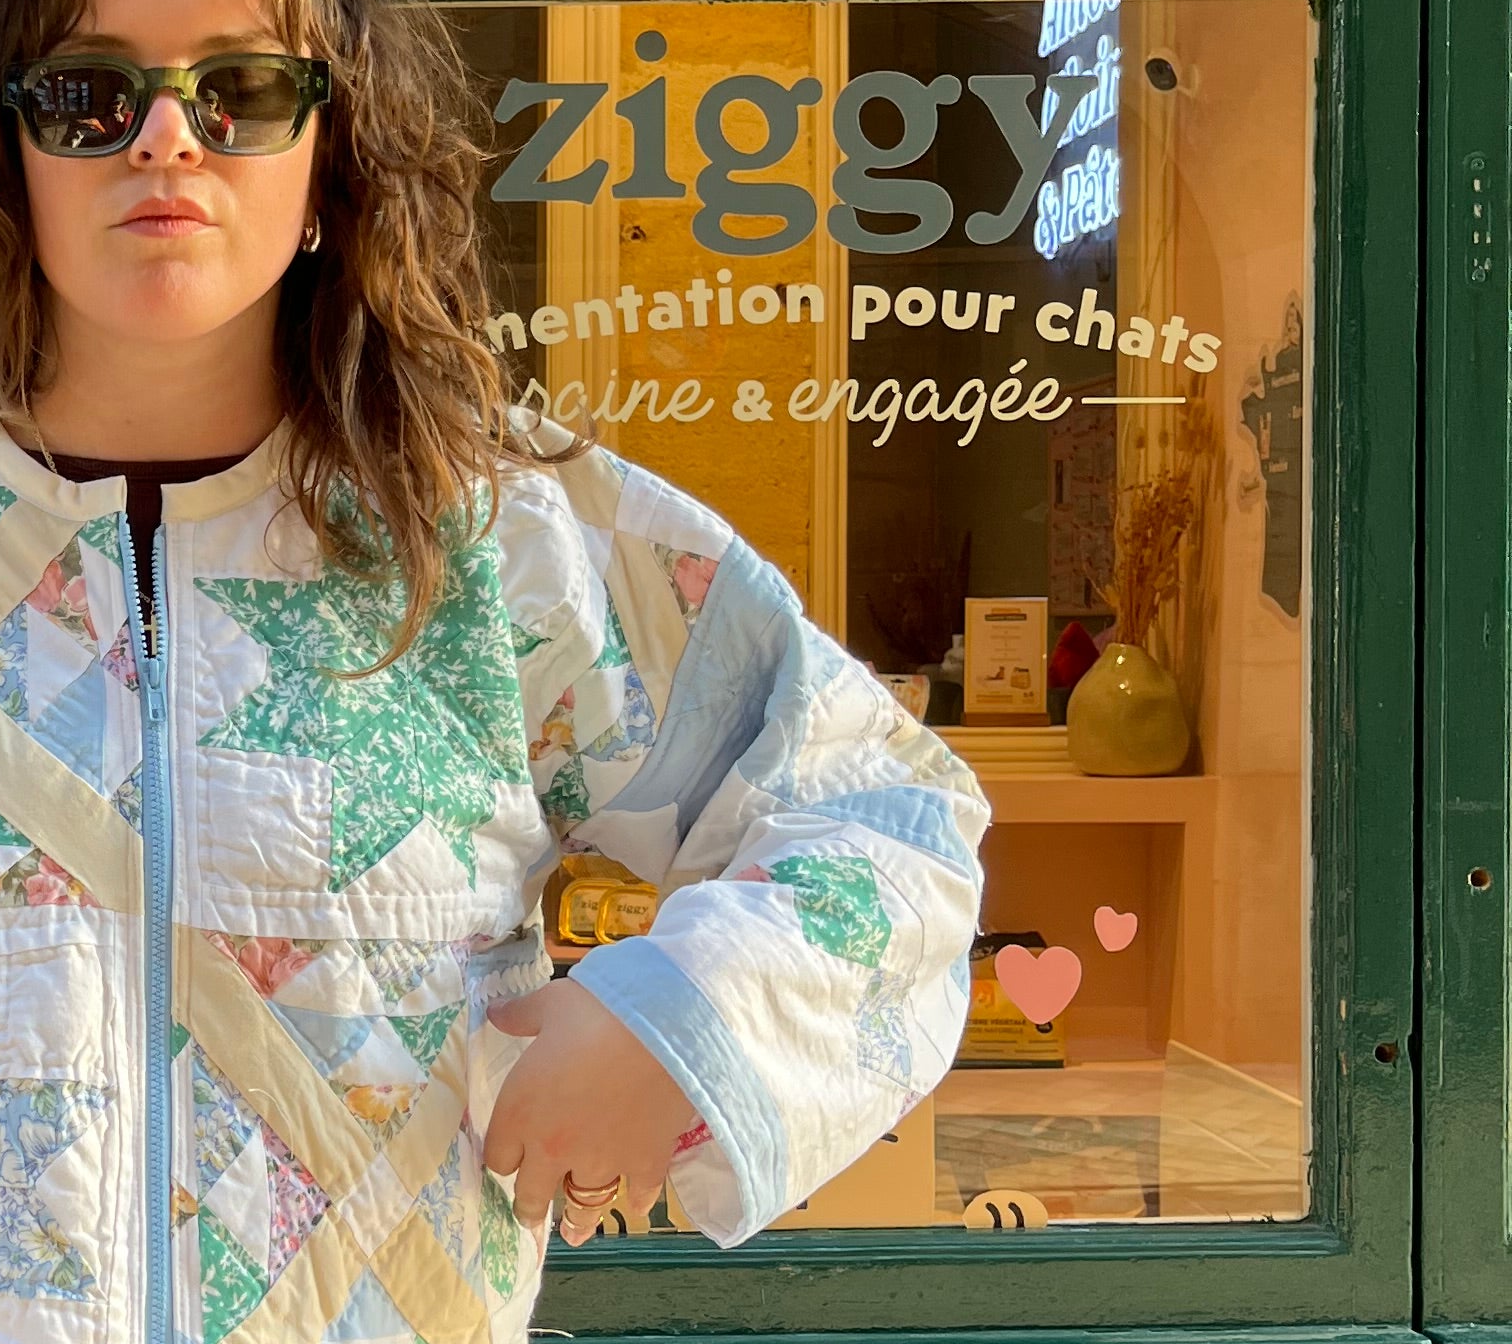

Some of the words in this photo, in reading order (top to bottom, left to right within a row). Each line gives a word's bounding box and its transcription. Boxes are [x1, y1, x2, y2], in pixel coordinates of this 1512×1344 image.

[490, 30, 1098, 254] ziggy
[487, 268, 825, 354] mentation
[850, 284, 1016, 341] pour
[1035, 288, 1222, 373] chats
[731, 379, 774, 423] &
[788, 358, 1073, 448] engagée
[581, 899, 599, 911] zig
